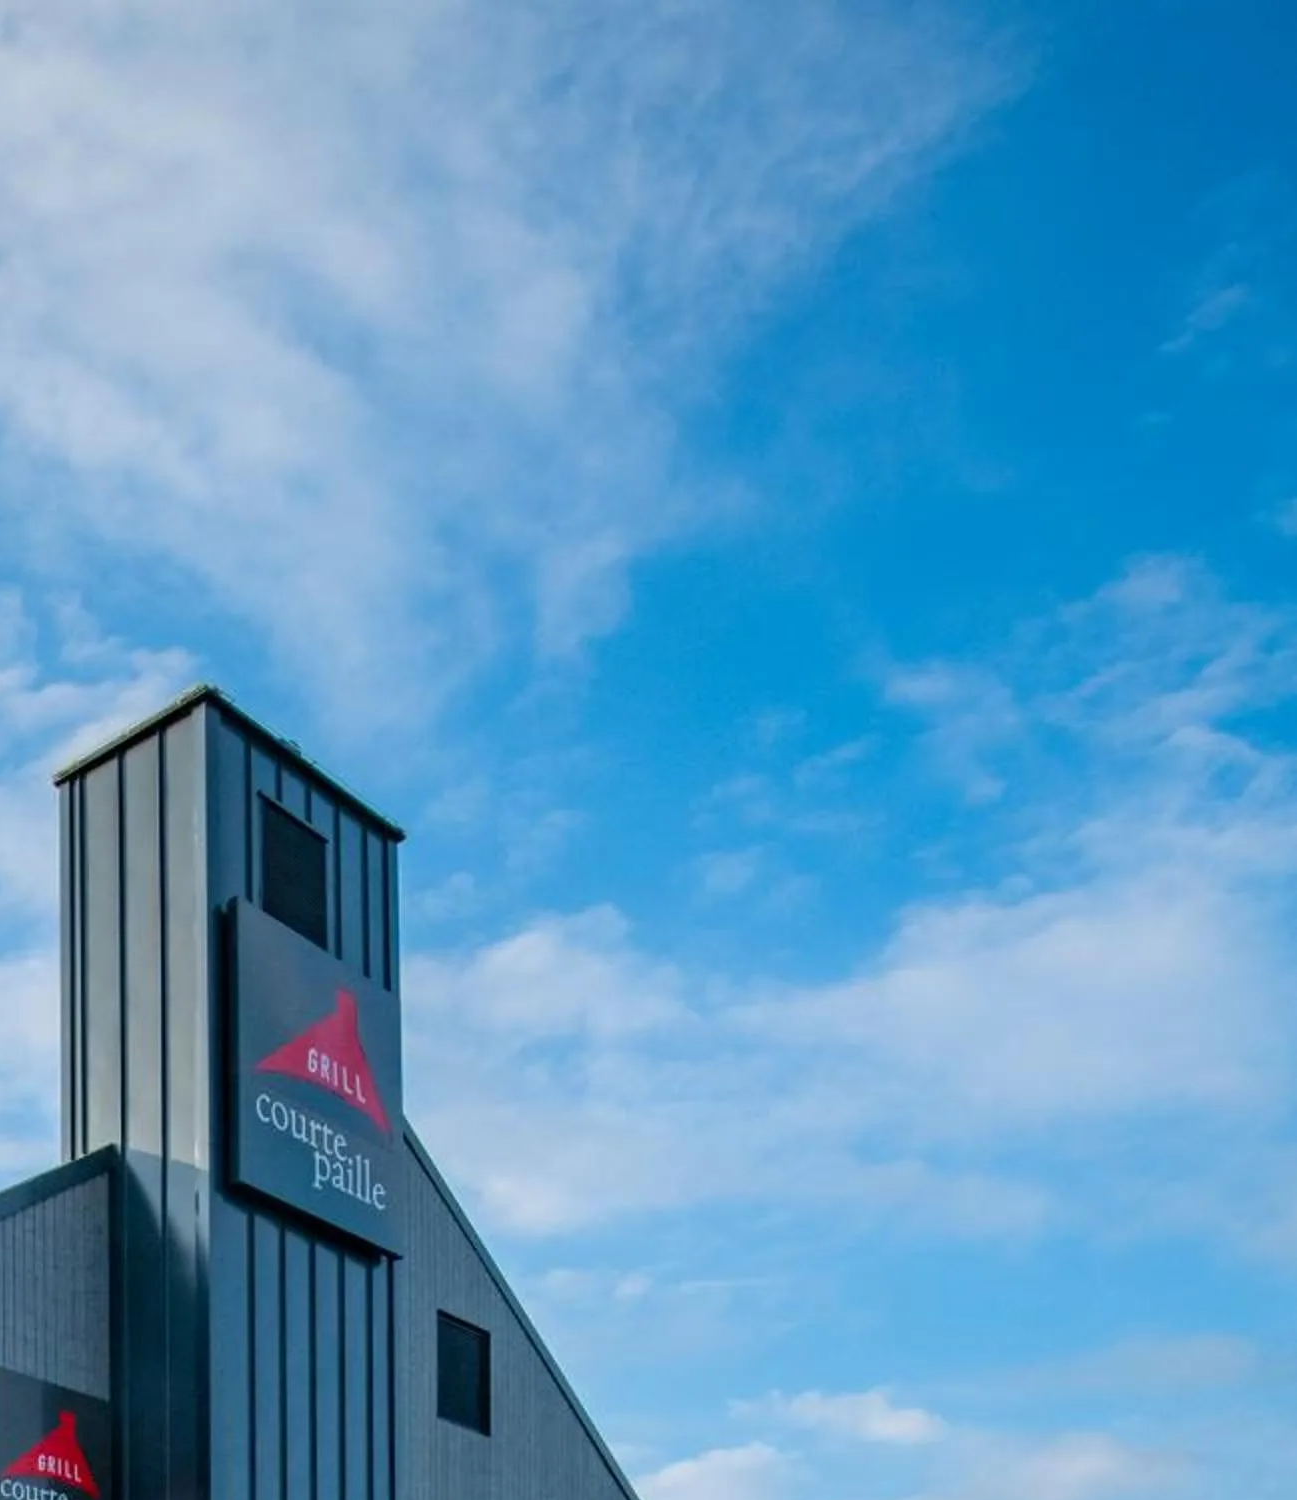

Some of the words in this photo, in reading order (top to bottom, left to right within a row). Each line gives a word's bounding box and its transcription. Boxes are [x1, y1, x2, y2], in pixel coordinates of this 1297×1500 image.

[306, 1047, 366, 1104] GRILL
[255, 1093, 348, 1162] courte
[312, 1151, 386, 1211] paille
[37, 1453, 82, 1483] GRILL
